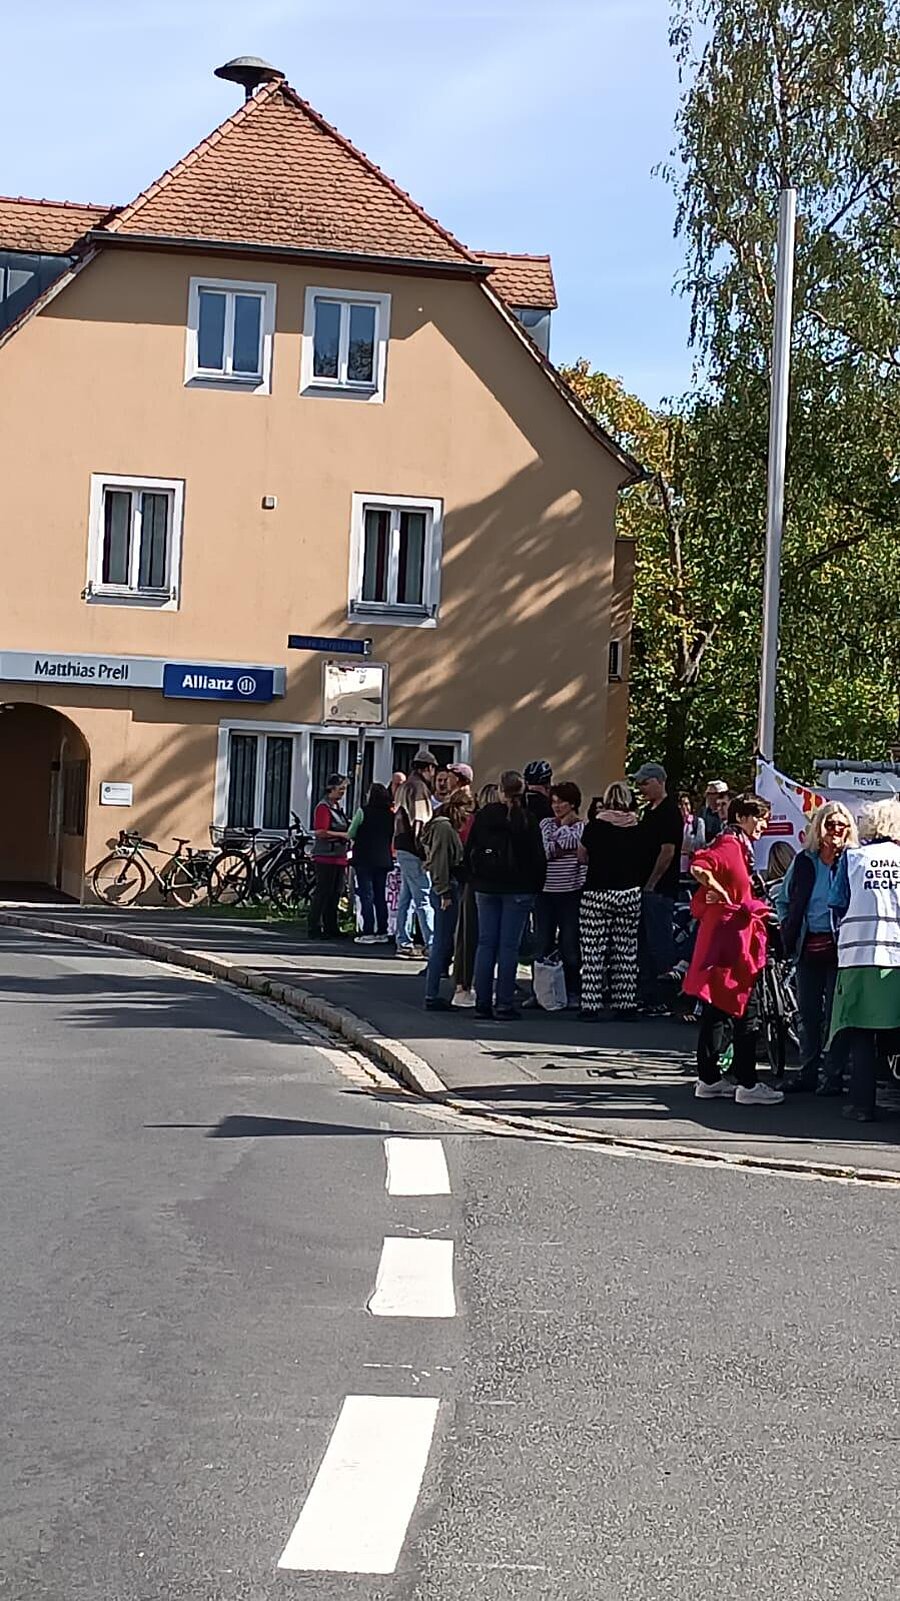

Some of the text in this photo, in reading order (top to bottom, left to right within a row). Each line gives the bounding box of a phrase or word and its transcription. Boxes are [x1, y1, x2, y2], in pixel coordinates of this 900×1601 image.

[34, 660, 129, 680] Matthias Prell
[182, 674, 234, 690] Allianz
[853, 776, 881, 786] REWE
[870, 859, 900, 868] OMA
[865, 869, 899, 879] GEGE
